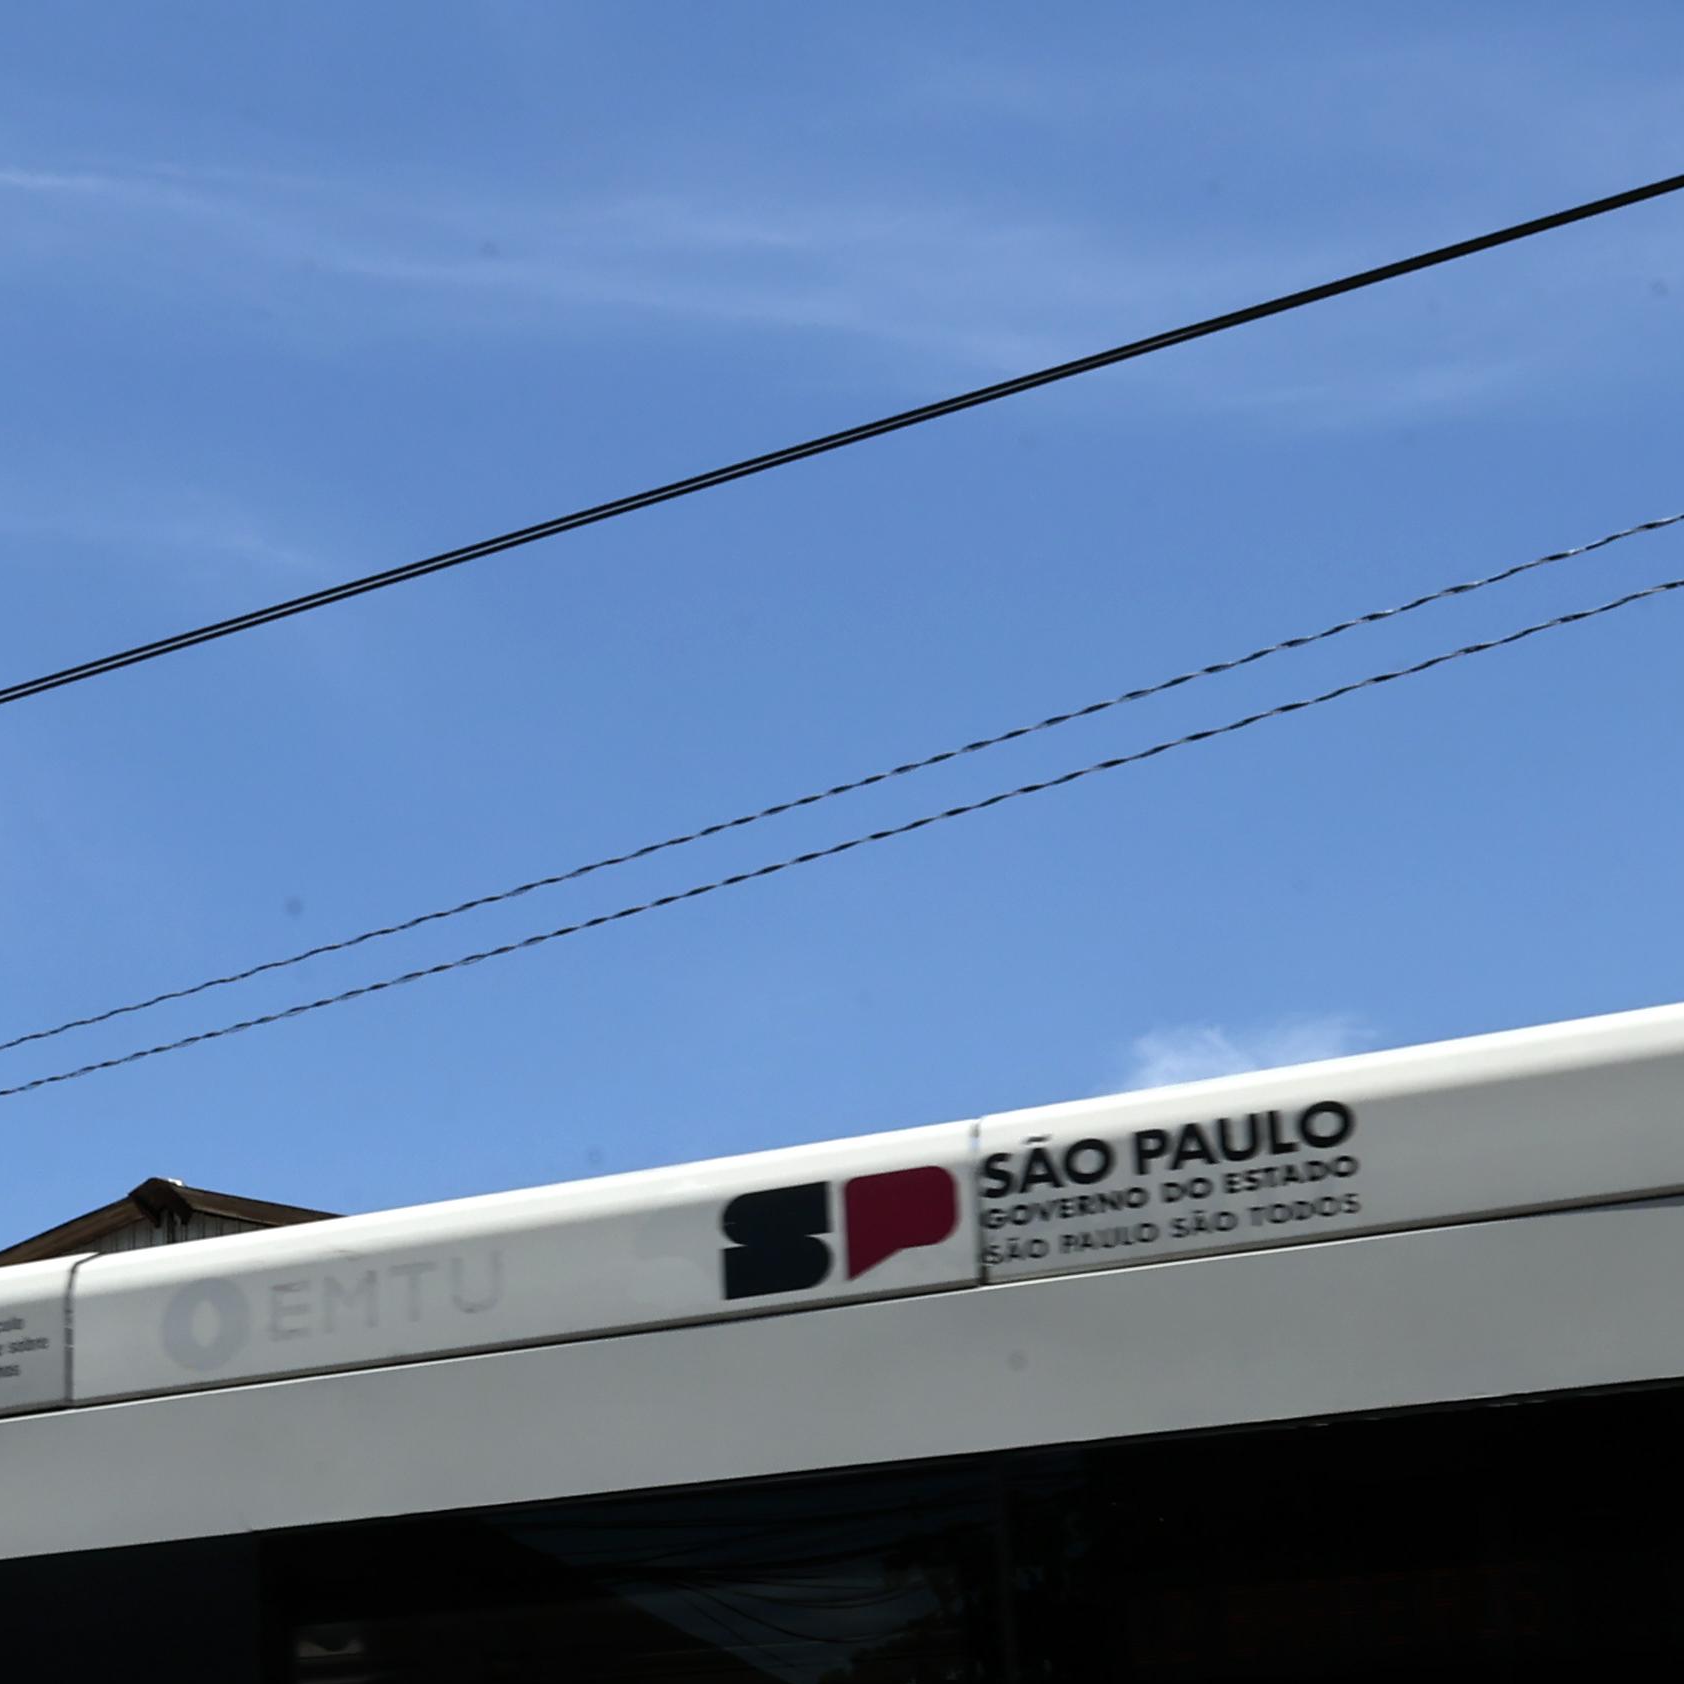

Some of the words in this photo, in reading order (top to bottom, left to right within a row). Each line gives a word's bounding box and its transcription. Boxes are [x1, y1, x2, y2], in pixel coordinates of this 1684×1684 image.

[981, 1135, 1113, 1199] SÃO
[1133, 1101, 1353, 1175] PAULO
[981, 1186, 1150, 1230] GOVERNO
[1160, 1177, 1214, 1204] DO
[1223, 1155, 1359, 1194] ESTADO
[1058, 1222, 1160, 1255] PAULO
[1169, 1209, 1239, 1239] SÃO
[1248, 1192, 1361, 1227] TODOS
[269, 1249, 506, 1342] EMTU
